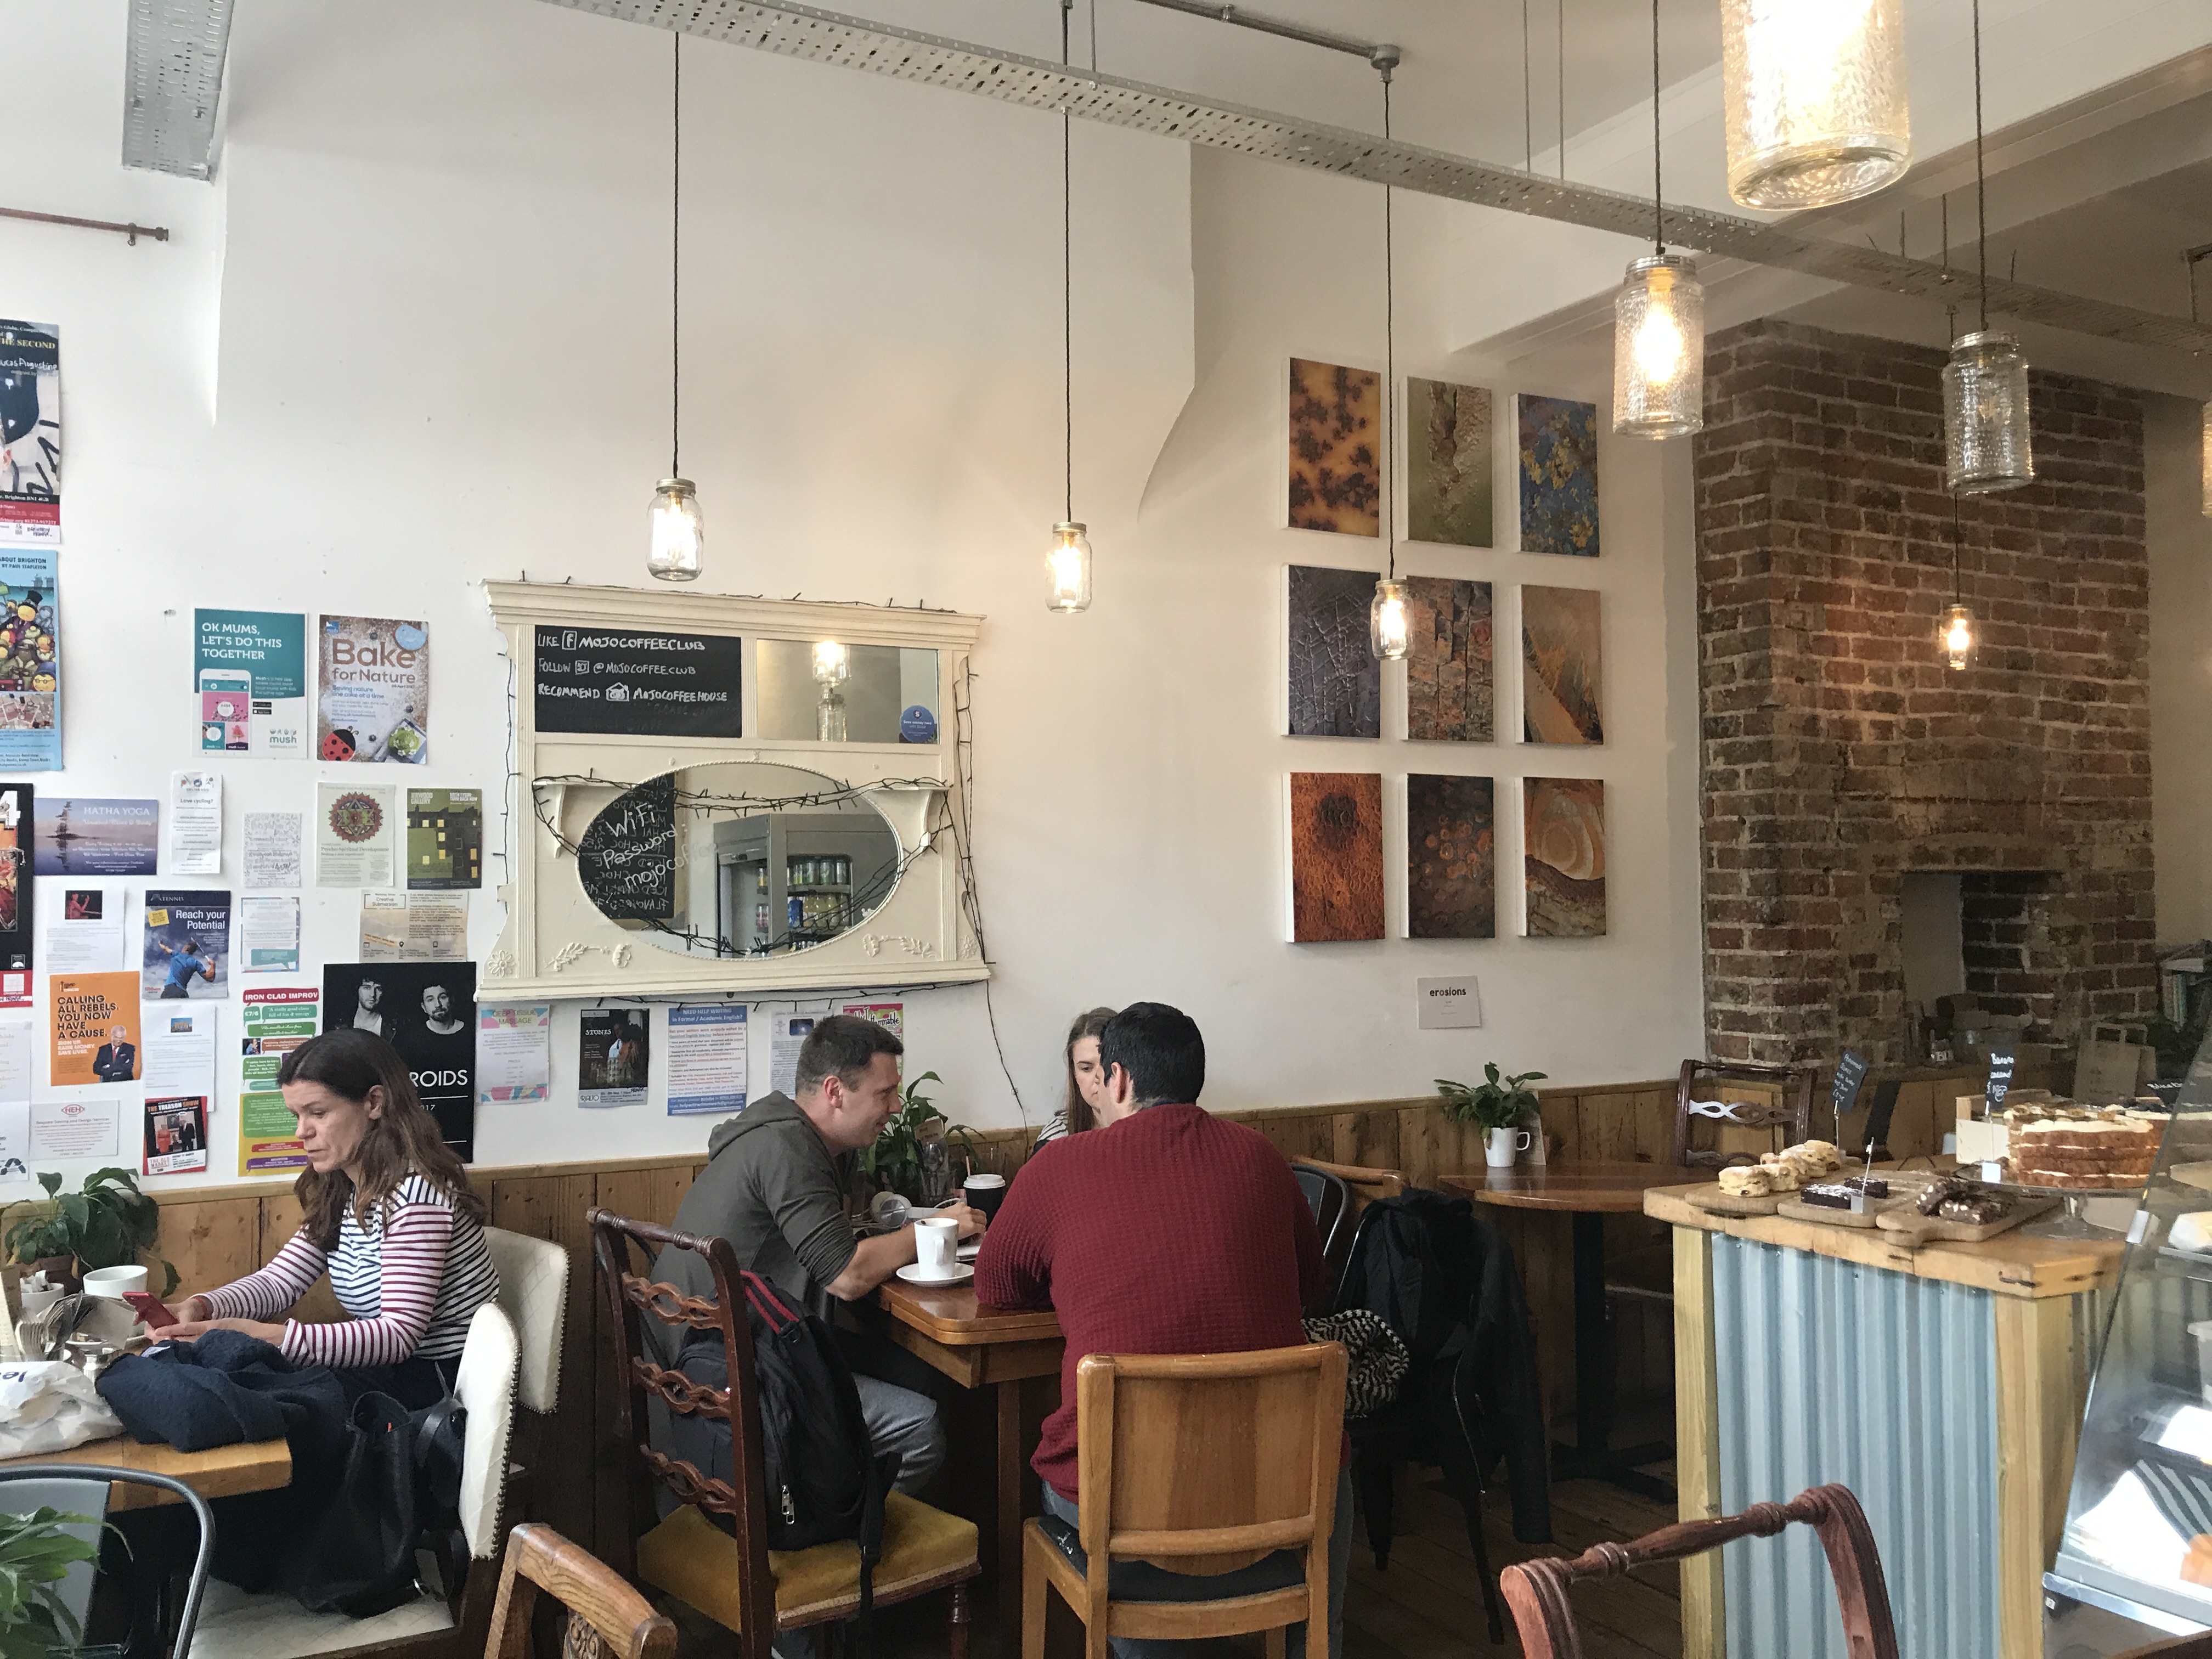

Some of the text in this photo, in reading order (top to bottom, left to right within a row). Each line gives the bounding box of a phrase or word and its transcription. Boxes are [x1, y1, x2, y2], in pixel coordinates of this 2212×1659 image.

[0, 337, 55, 349] HE SECOND
[19, 357, 57, 371] Augustine
[202, 622, 261, 635] OK MUMS,
[202, 635, 282, 648] LET'S DO THIS
[537, 634, 560, 647] LIKE
[578, 635, 706, 651] MOJOCOFFEECLUB
[202, 648, 265, 659] TOGETHER
[332, 639, 416, 668] Bake
[538, 657, 571, 673] FOLLOW
[332, 668, 416, 684] for Nature
[332, 685, 353, 694] Saving
[538, 683, 727, 703] RECOMMEND MOJOCOFFEEHOUSE
[84, 807, 150, 816] HATHA YOGA
[603, 823, 678, 869] Password
[176, 910, 203, 919] Reach
[206, 912, 225, 921] your
[187, 921, 225, 929] Potential
[1429, 987, 1466, 997] erosions
[58, 995, 106, 1005] CALLING
[58, 1003, 120, 1013] ALL REBELS.
[58, 1011, 112, 1022] YOU NOW
[58, 1022, 86, 1031] HAVE
[58, 1029, 109, 1040] A CAUSE.
[409, 1069, 468, 1087] ROIDS
[158, 1102, 182, 1111] TREASON
